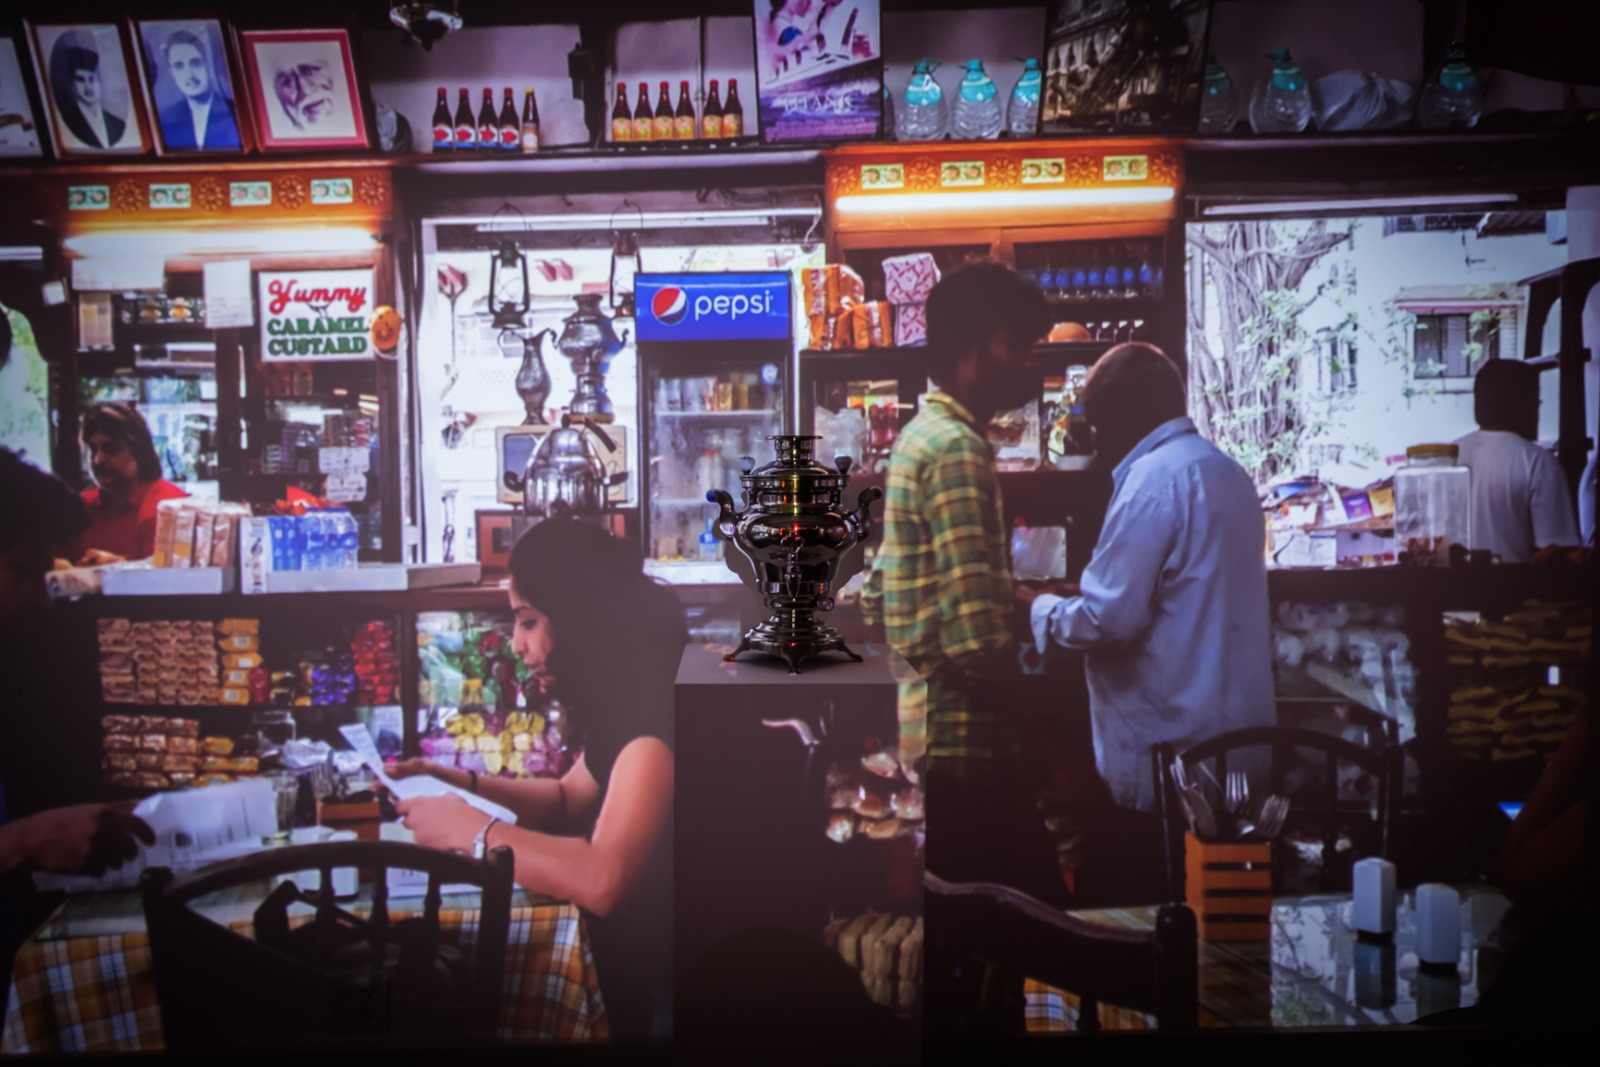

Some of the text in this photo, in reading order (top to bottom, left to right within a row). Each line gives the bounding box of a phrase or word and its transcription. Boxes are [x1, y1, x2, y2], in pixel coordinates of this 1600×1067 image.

[268, 279, 367, 315] Yummy
[695, 289, 770, 321] pepsi
[267, 316, 369, 336] CARAMEL
[267, 336, 367, 356] CUSTARD
